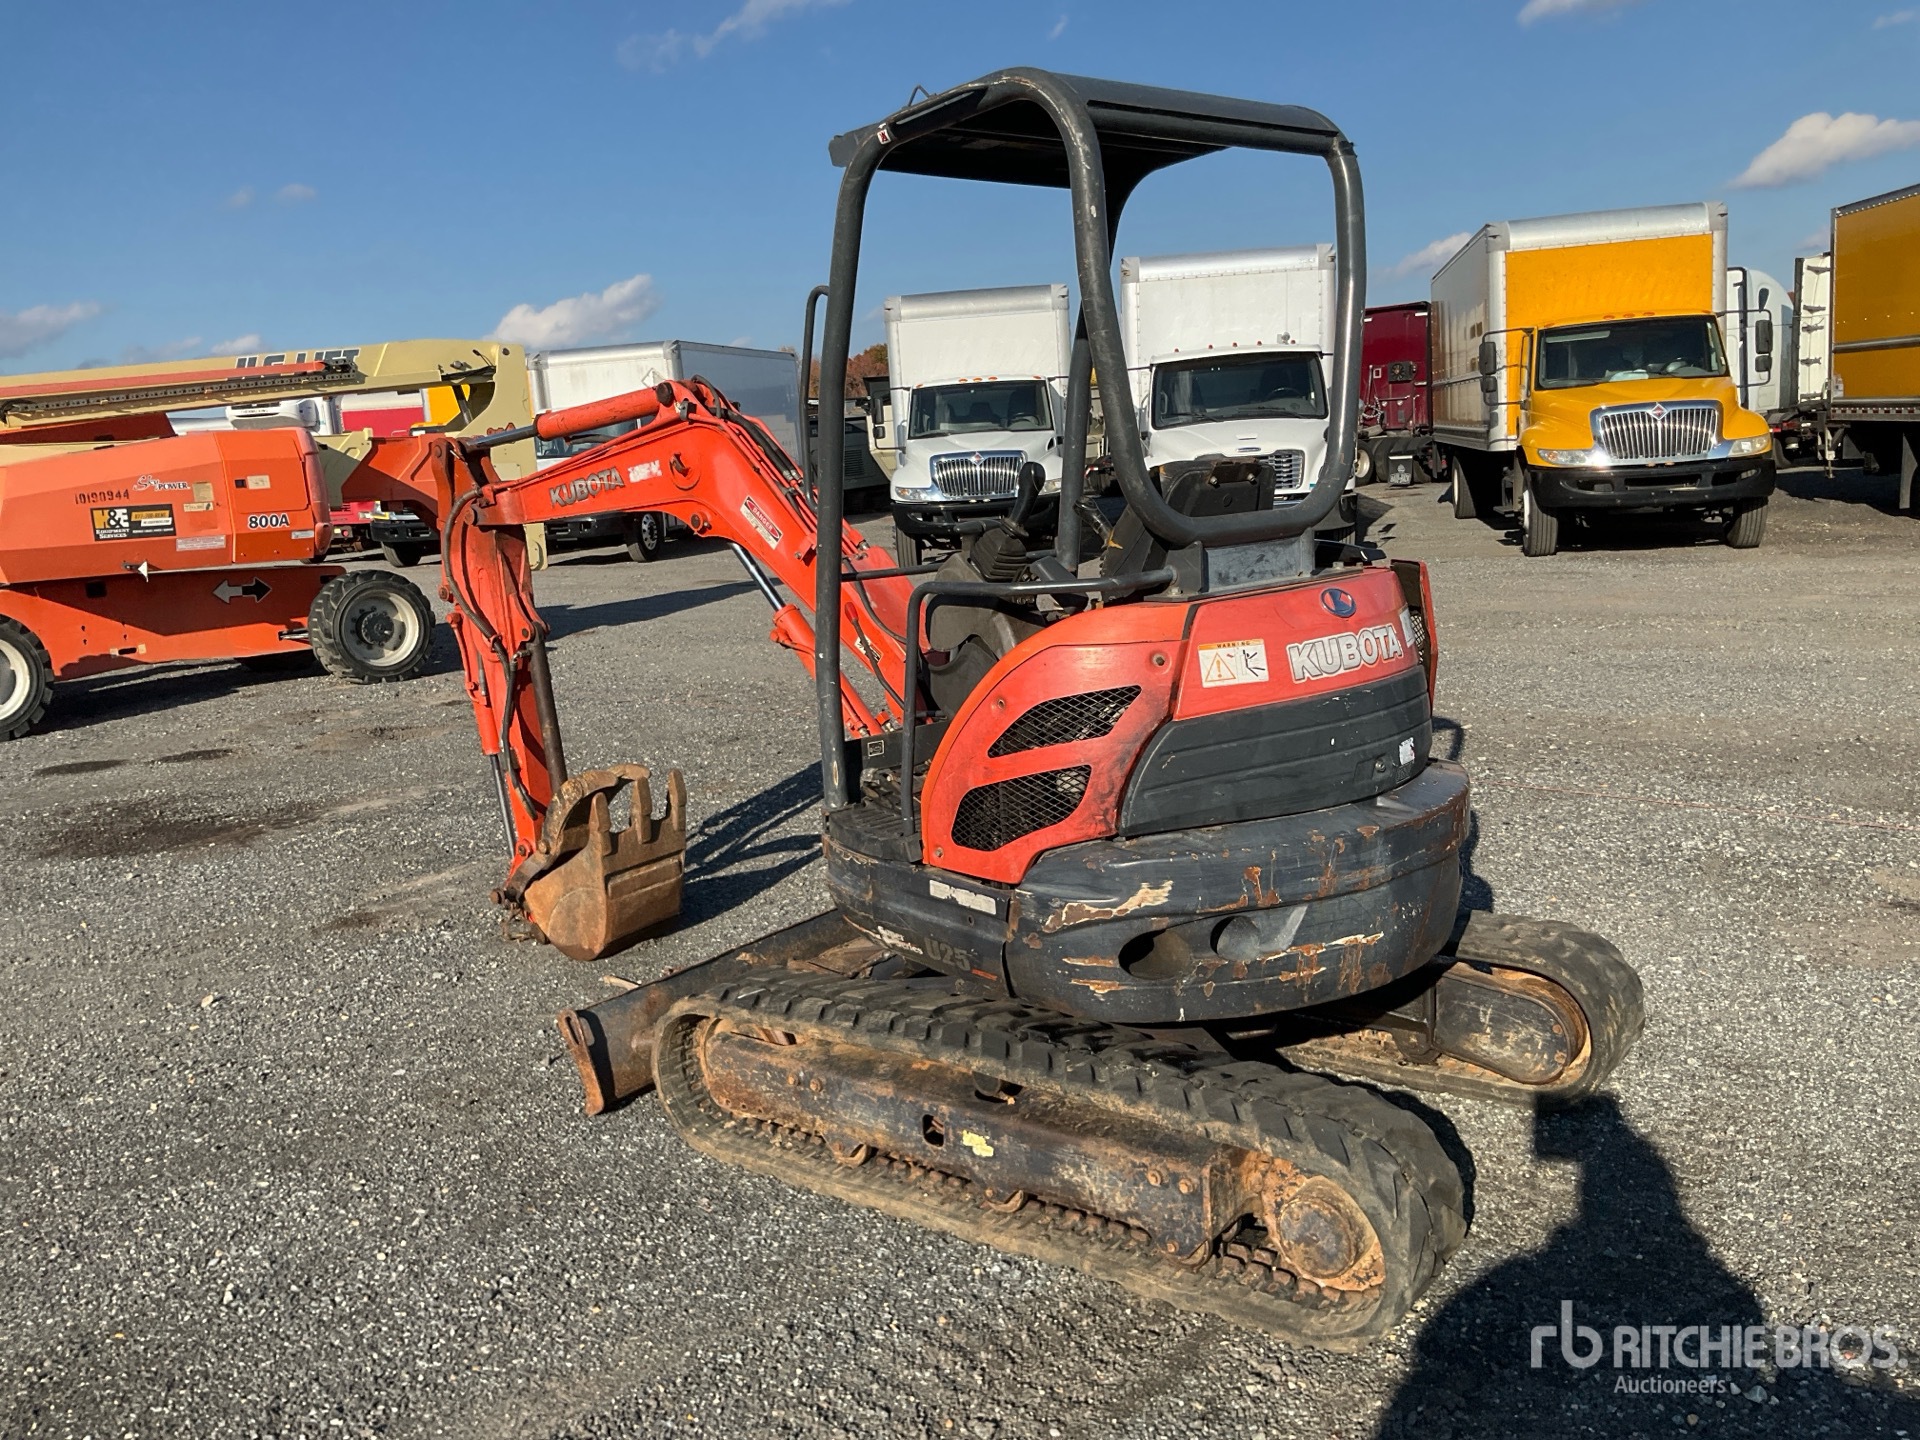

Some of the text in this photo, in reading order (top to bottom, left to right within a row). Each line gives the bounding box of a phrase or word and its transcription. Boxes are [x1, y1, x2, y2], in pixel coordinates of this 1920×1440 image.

[158, 482, 188, 490] POWER
[549, 466, 625, 508] KUBOTA
[92, 508, 130, 529] H&E
[248, 514, 290, 529] 800A
[752, 507, 773, 531] DANGER
[1216, 641, 1251, 649] WARNING
[1287, 623, 1403, 683] KUBOTA
[925, 938, 971, 971] U25
